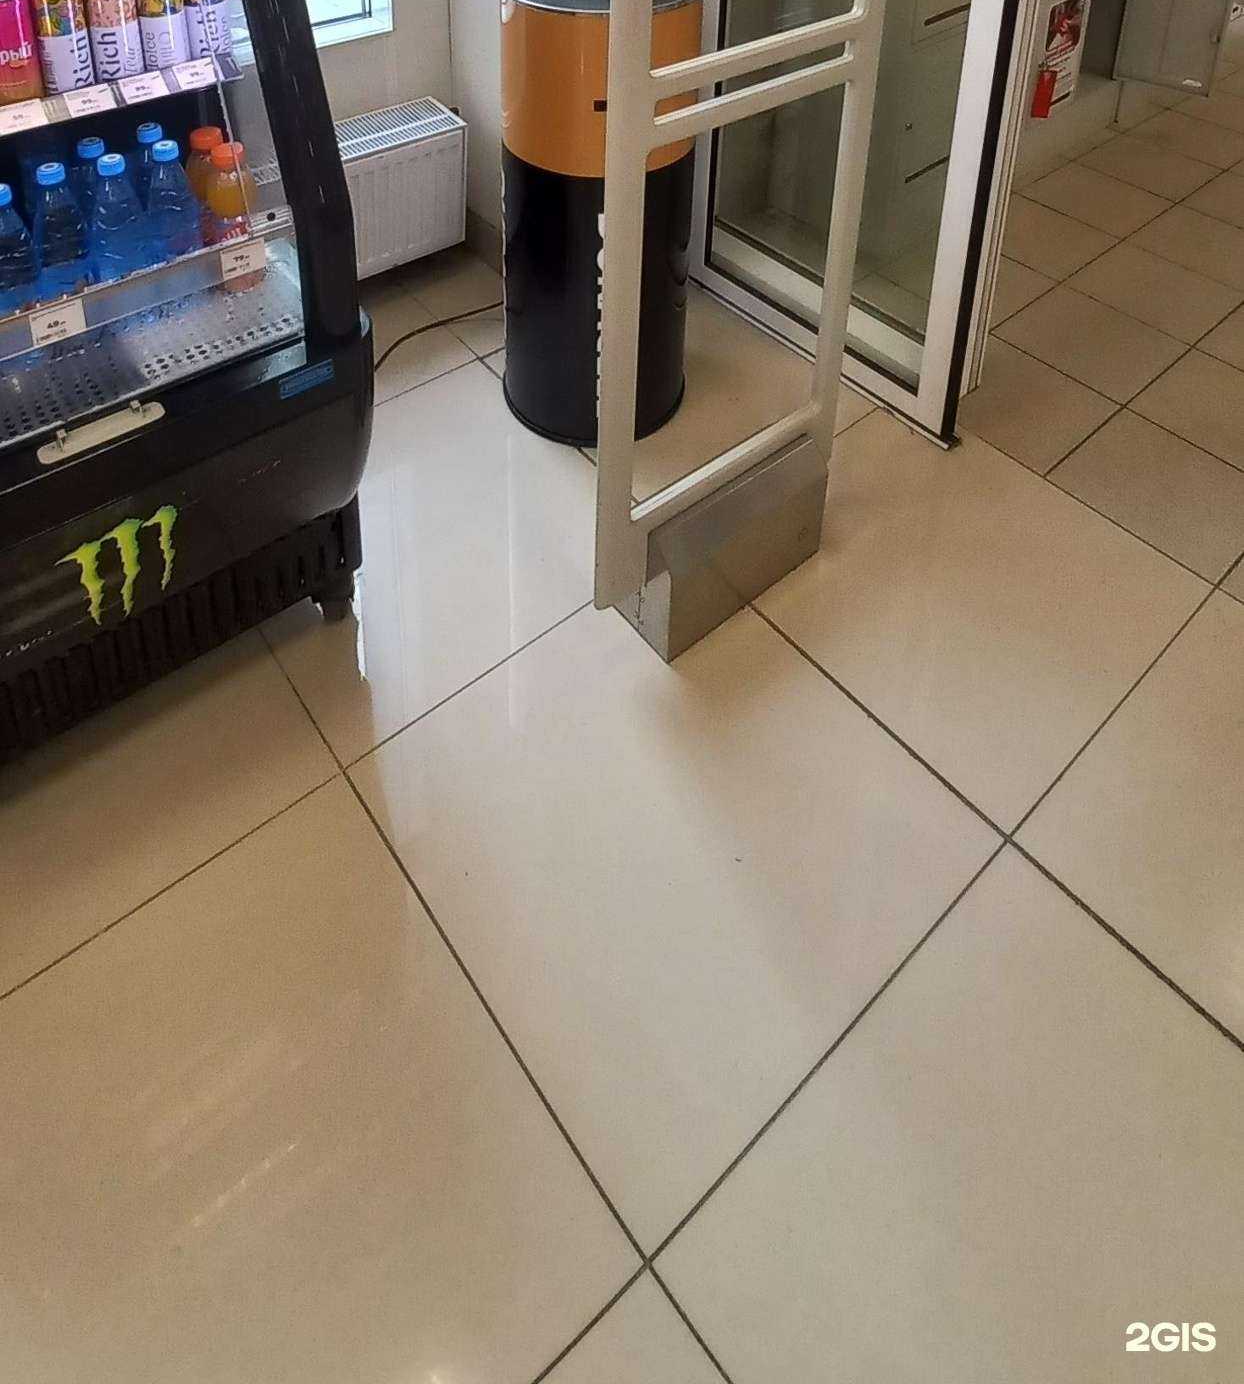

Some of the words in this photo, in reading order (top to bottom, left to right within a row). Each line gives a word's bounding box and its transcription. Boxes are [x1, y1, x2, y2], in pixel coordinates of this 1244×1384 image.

[0, 41, 33, 66] рый
[69, 36, 94, 87] Rich
[96, 31, 121, 82] Rich
